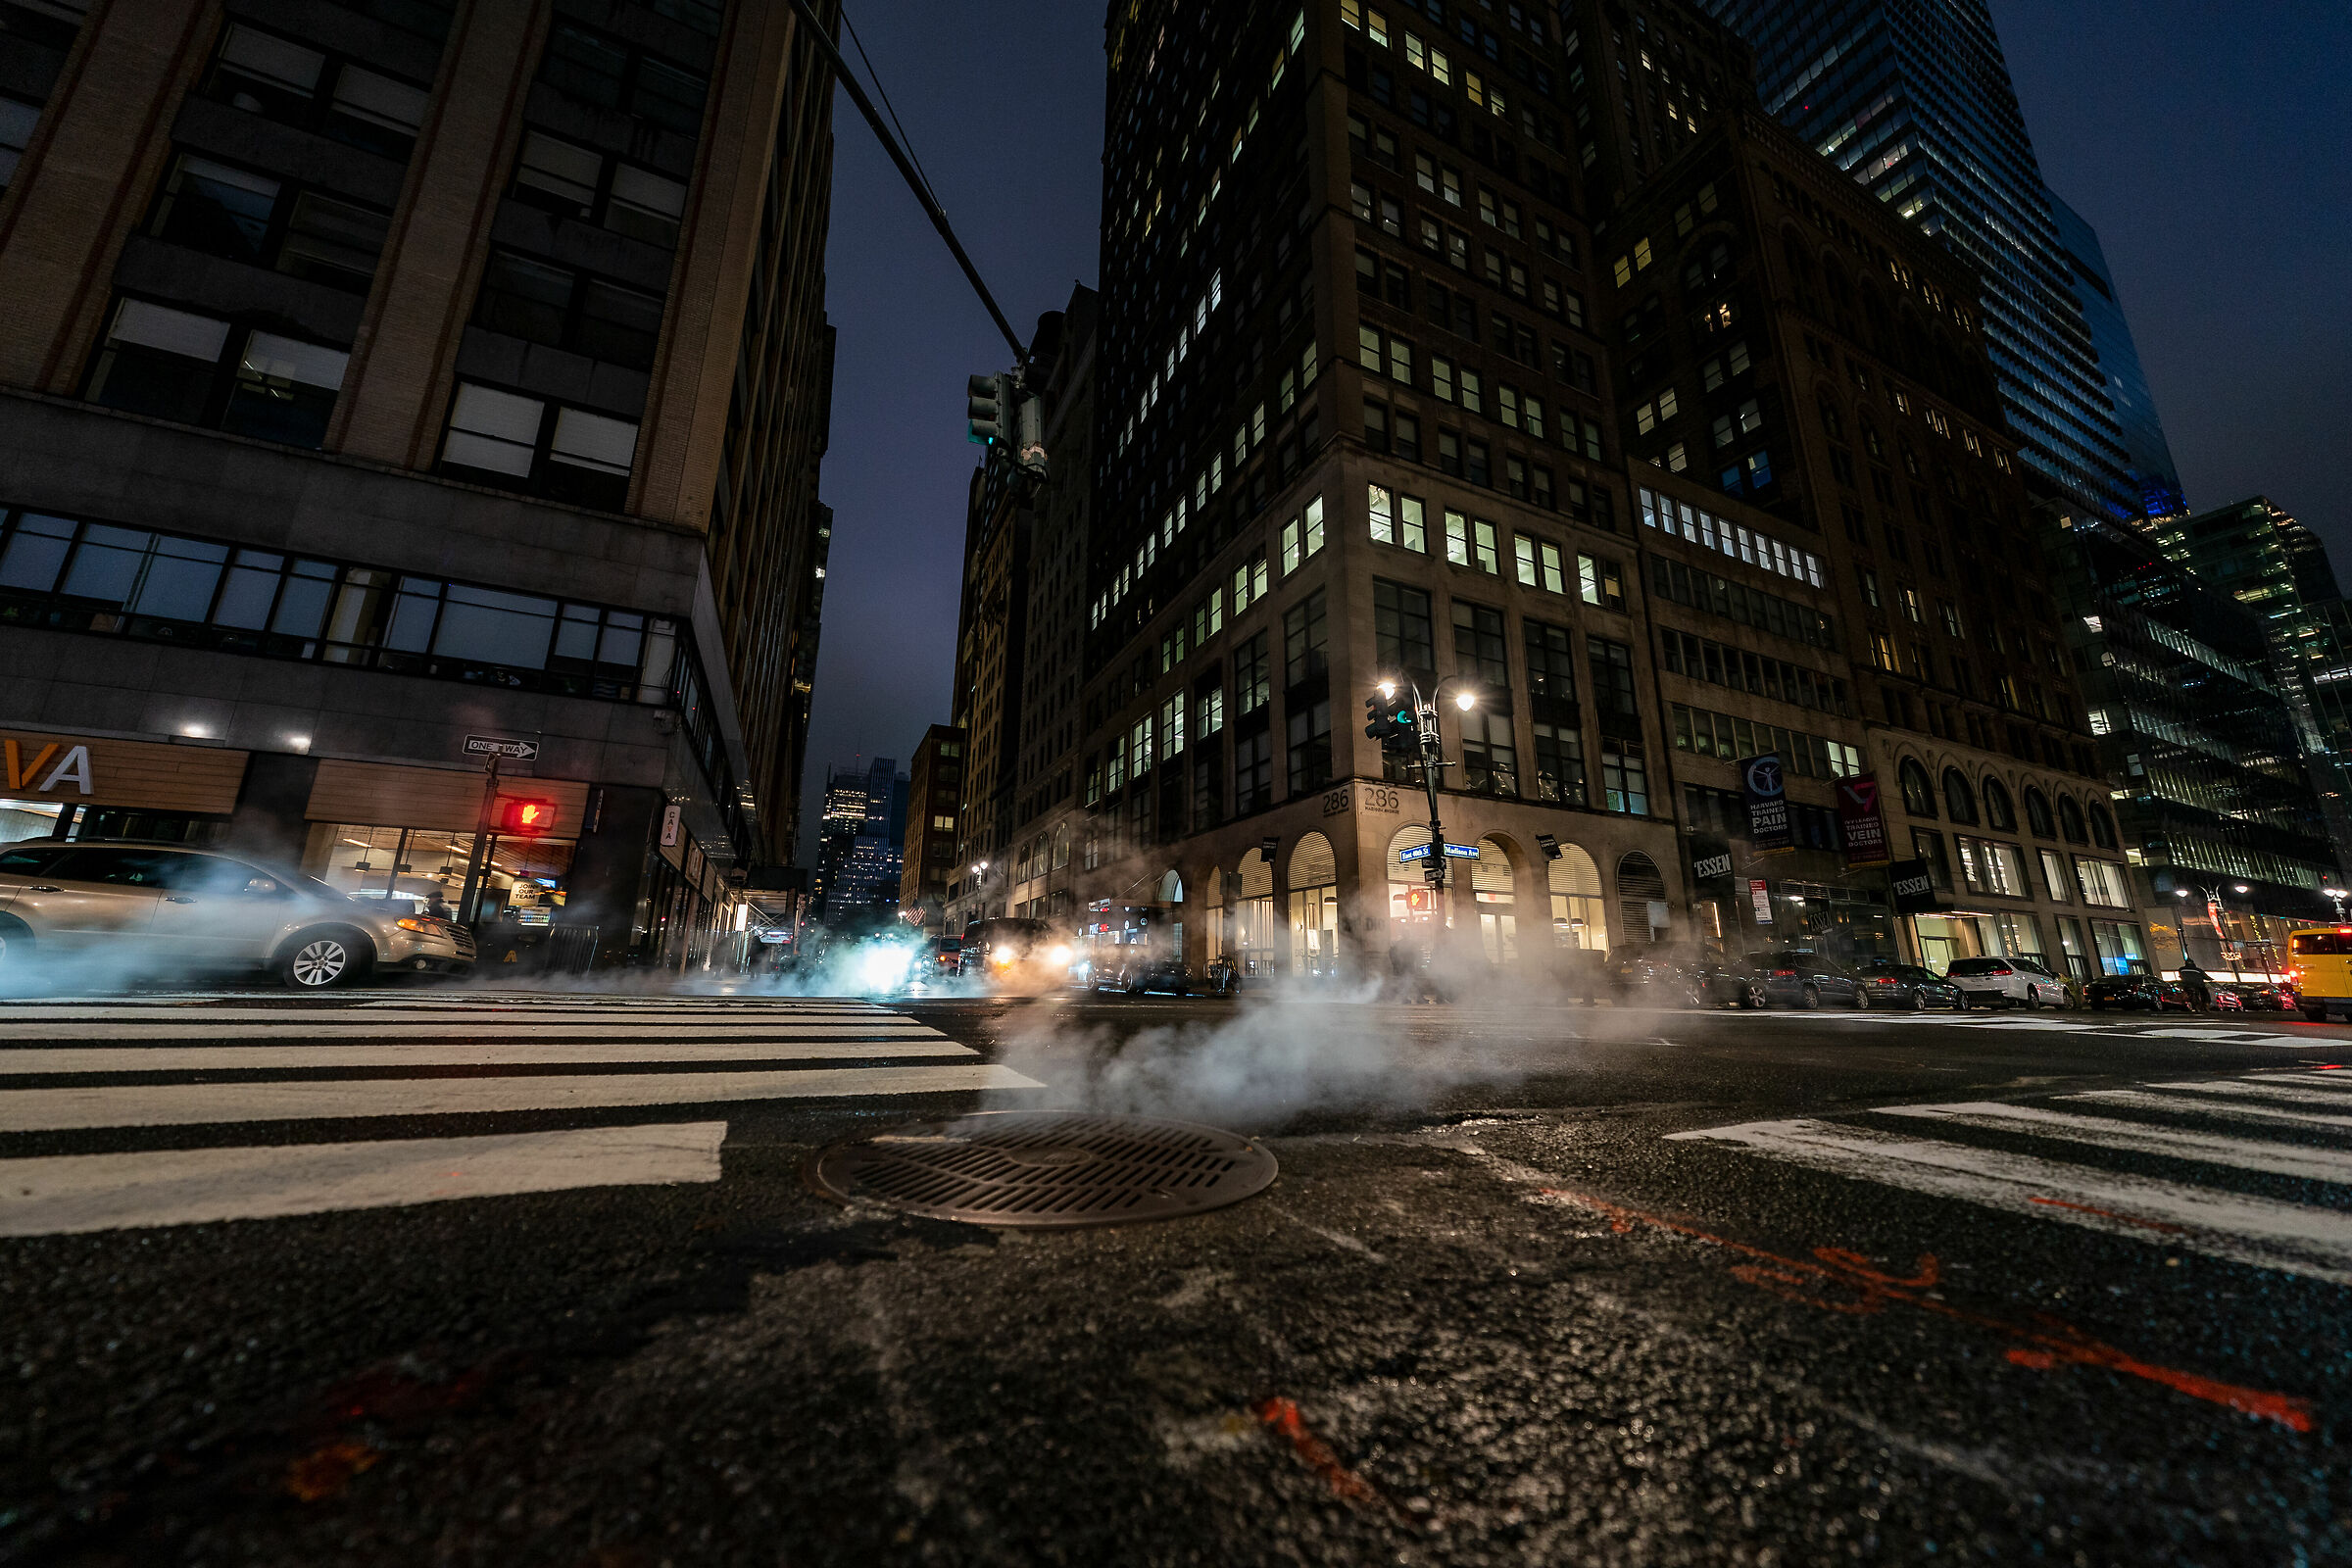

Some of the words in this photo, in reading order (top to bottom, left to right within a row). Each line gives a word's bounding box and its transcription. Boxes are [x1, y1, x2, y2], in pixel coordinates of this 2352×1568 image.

[471, 741, 494, 751] ONE
[505, 745, 528, 754] WAY
[1323, 789, 1348, 813] 286
[1365, 787, 1399, 808] 286
[1750, 800, 1785, 810] HARVARD
[1751, 806, 1786, 816] TRAINED
[666, 811, 675, 840] CAVA
[1751, 812, 1787, 827] PAIN
[1846, 821, 1880, 831] TRAINED
[1753, 823, 1788, 834] DOCTORS
[1846, 828, 1882, 841] VEIN
